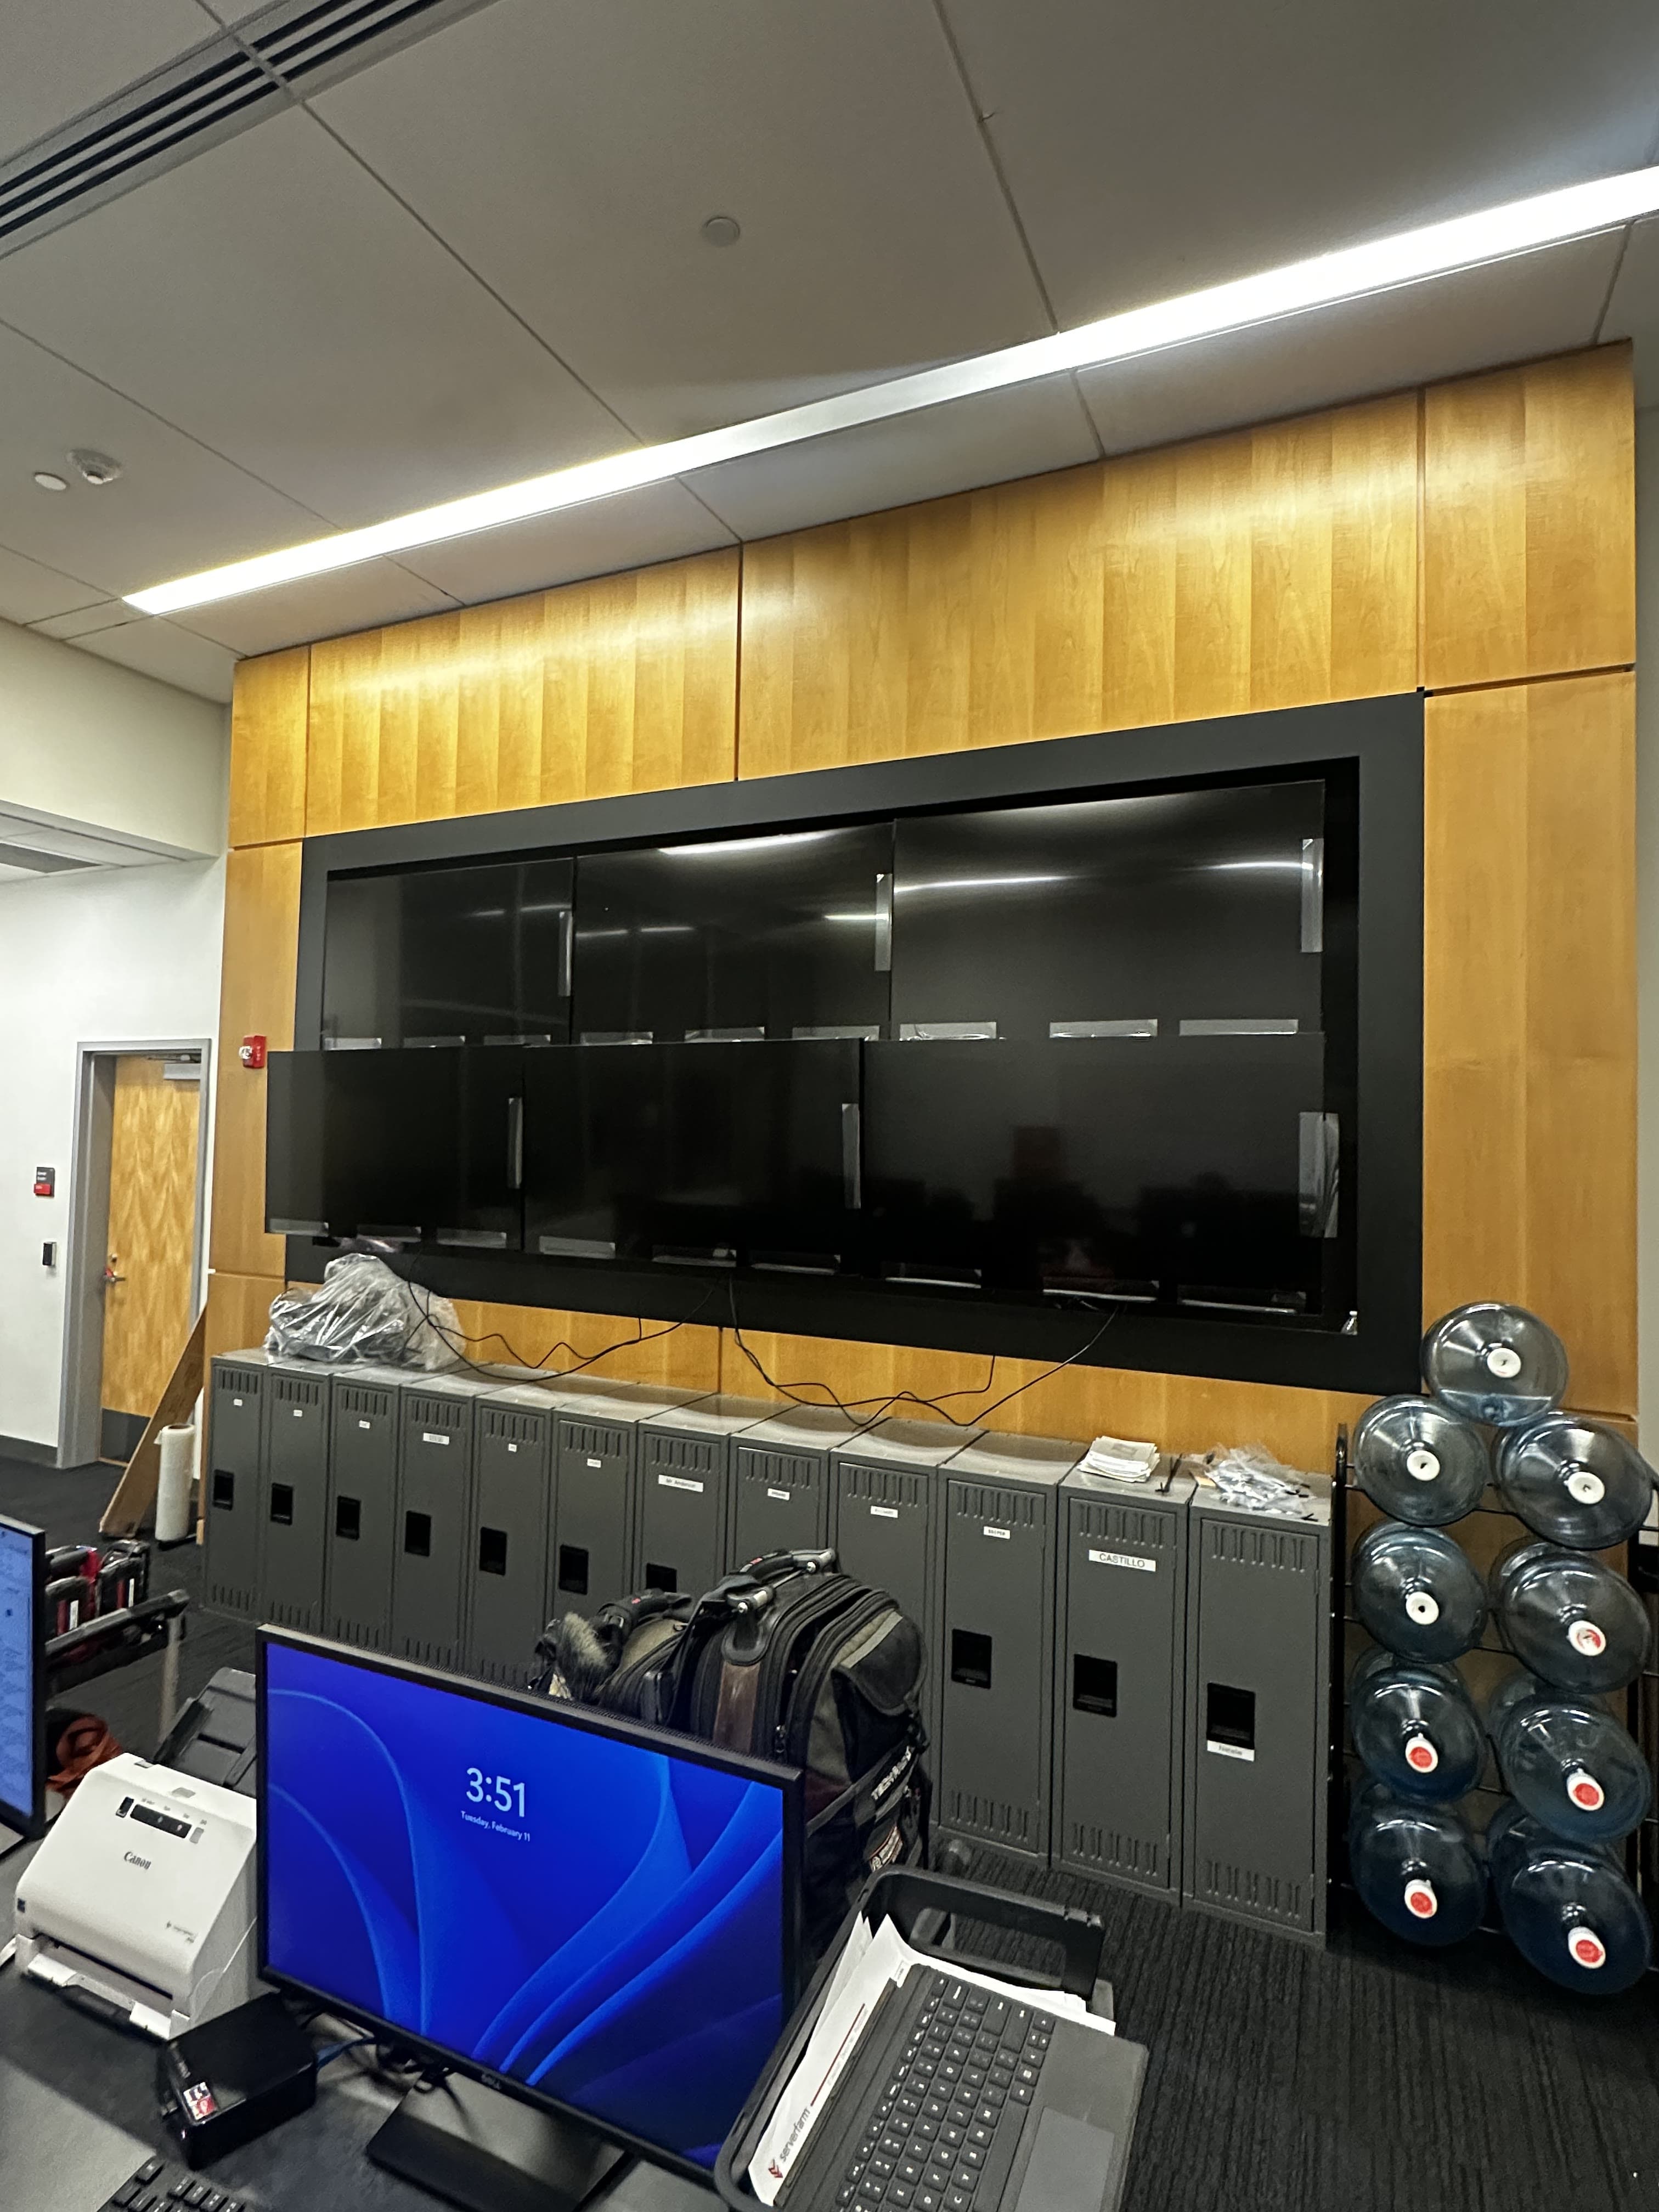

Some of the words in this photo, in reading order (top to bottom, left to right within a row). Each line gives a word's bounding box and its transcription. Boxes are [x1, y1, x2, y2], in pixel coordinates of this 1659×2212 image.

[1099, 1553, 1145, 1567] CASTILLO
[466, 1768, 525, 1817] 3:51
[461, 1810, 491, 1829] Tuesday,
[492, 1821, 522, 1841] February
[524, 1832, 530, 1842] 11
[124, 1851, 151, 1870] Canon
[780, 2107, 810, 2163] serverfarm
